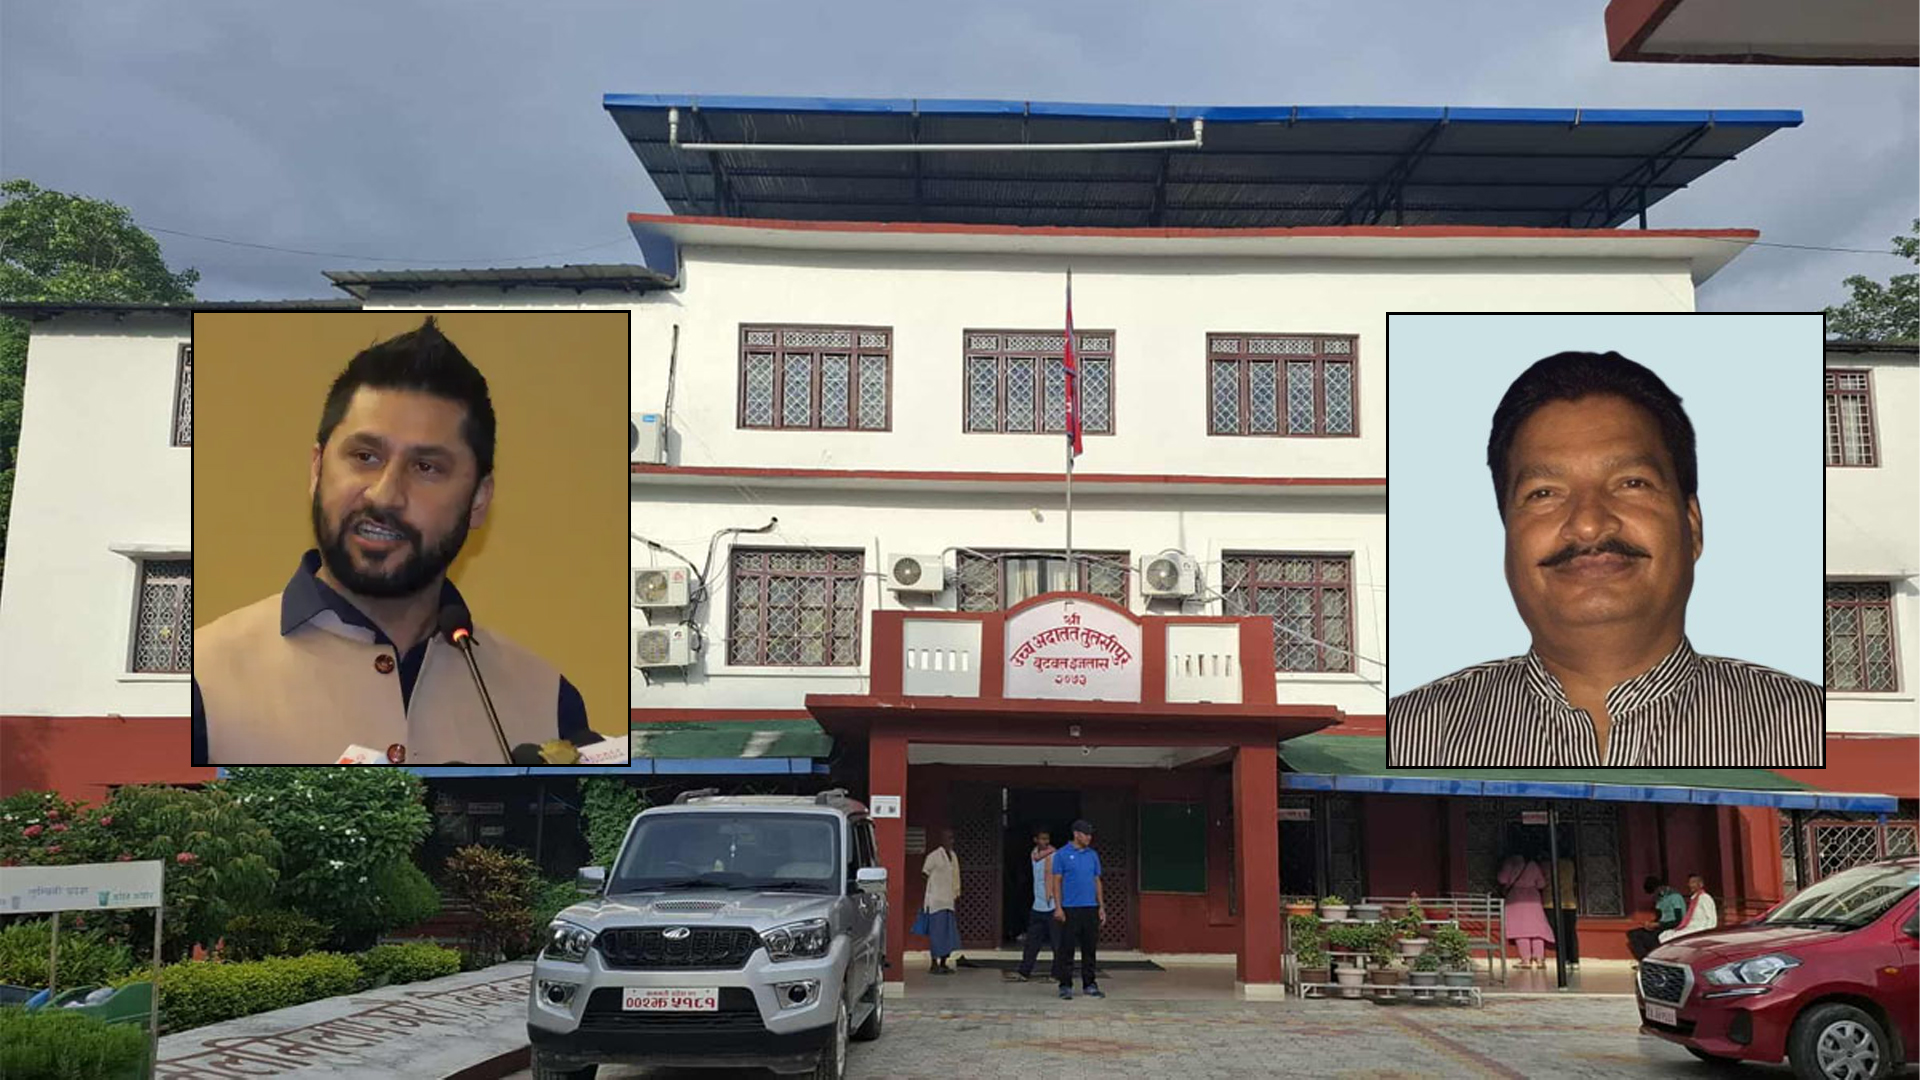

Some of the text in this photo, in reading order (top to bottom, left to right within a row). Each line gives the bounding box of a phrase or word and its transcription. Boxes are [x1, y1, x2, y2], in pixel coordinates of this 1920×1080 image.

[1063, 613, 1081, 625] श्री
[1009, 626, 1133, 669] उच्च अदालत तुलसीपुर
[1070, 657, 1109, 670] इजलास
[1055, 675, 1086, 685] २०७३
